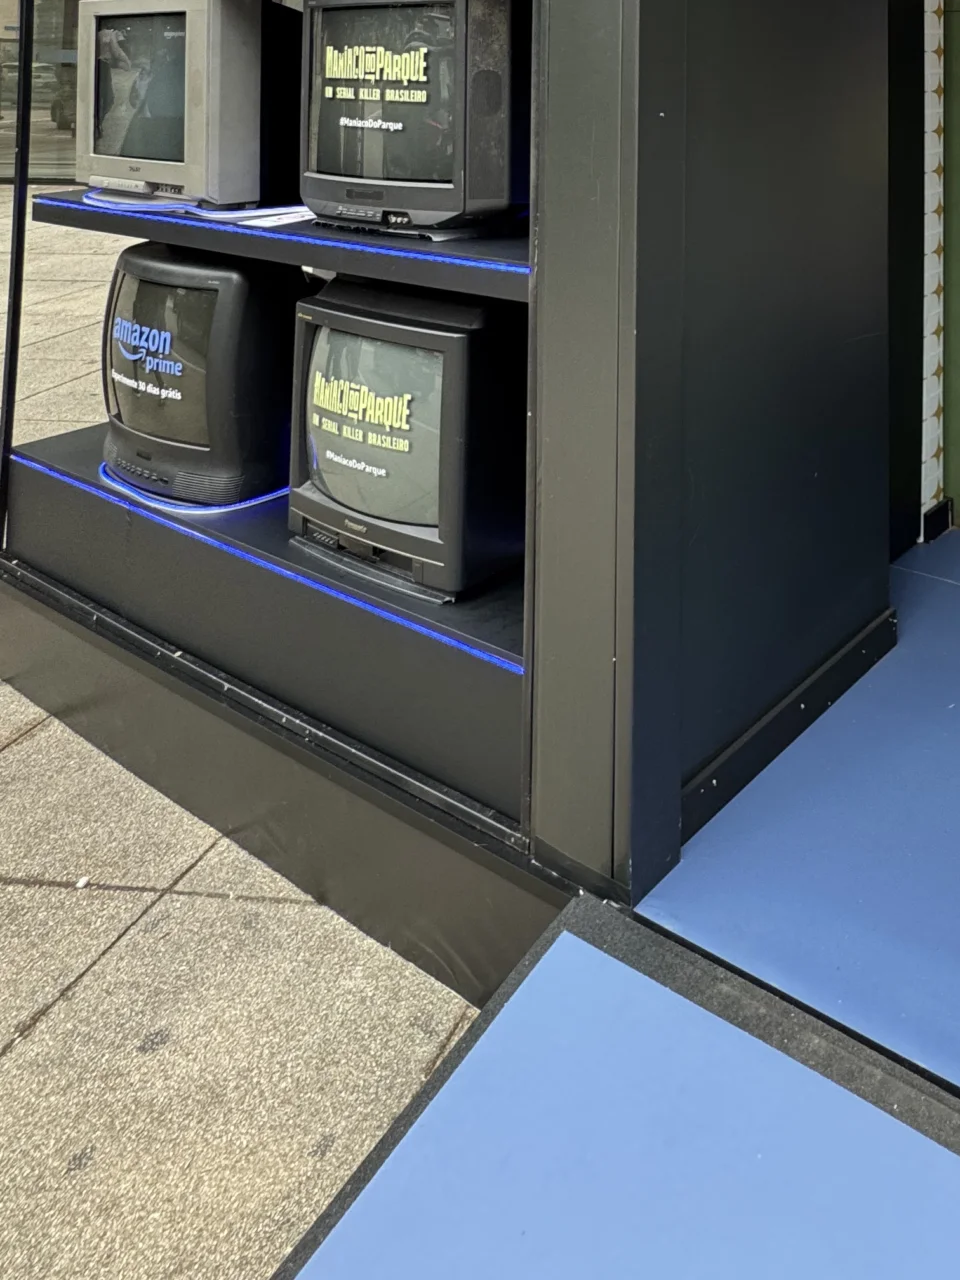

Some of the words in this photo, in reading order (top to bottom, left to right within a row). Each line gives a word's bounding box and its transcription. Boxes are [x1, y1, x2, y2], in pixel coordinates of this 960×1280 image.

[336, 86, 355, 99] SERIAL
[359, 87, 380, 100] KILLER
[385, 88, 427, 103] BRASILEIRO
[113, 317, 171, 355] amazon
[145, 353, 183, 376] prime
[146, 383, 160, 395] dias
[321, 417, 339, 435] SERIAL
[343, 425, 363, 442] KILLER
[367, 431, 409, 452] BRASILEIRO
